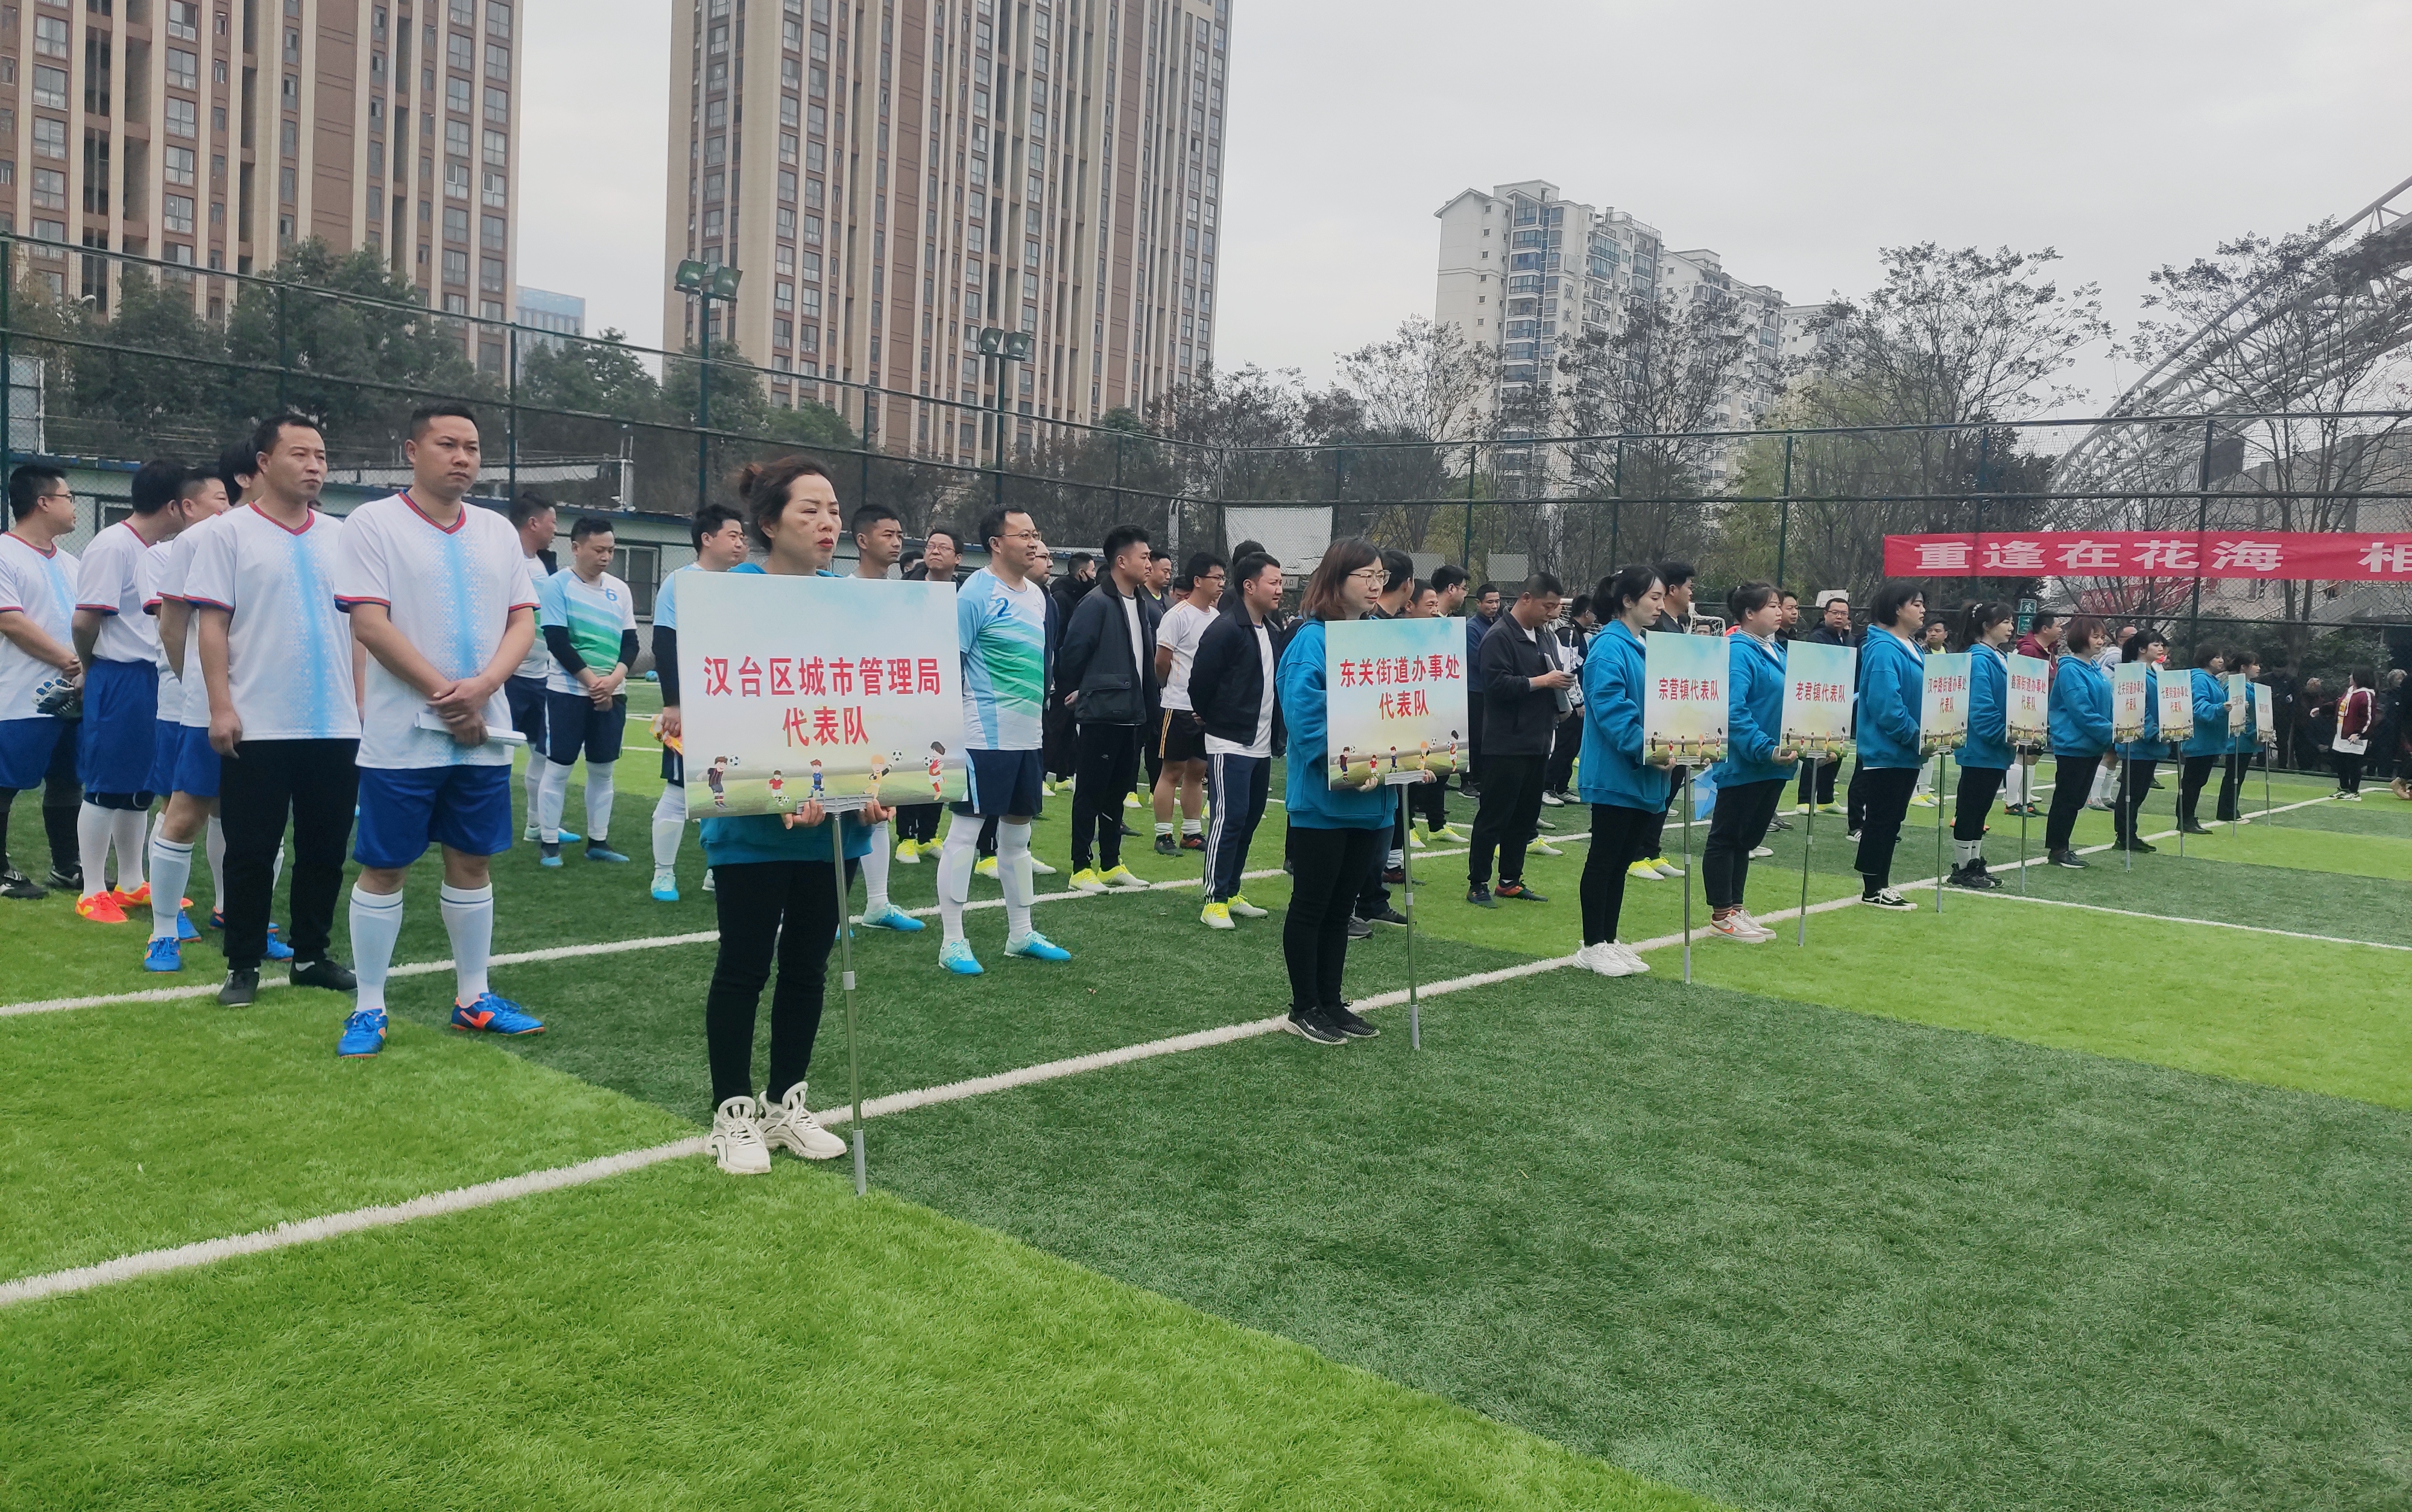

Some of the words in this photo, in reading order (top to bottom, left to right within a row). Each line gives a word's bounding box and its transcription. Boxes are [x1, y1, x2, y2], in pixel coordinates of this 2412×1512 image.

[1915, 540, 2284, 572] 重逢在花海
[605, 588, 618, 601] 6
[995, 597, 1012, 618] 2
[703, 655, 941, 697] 汉台区城市管理局
[1339, 653, 1460, 688] 东关街道办事处
[1658, 676, 1719, 702] 宗营镇代表队
[1795, 680, 1846, 704] 老君镇代表队
[1378, 688, 1430, 720] 代表队
[1940, 696, 1954, 713] 代表队
[782, 705, 869, 748] 代表队
